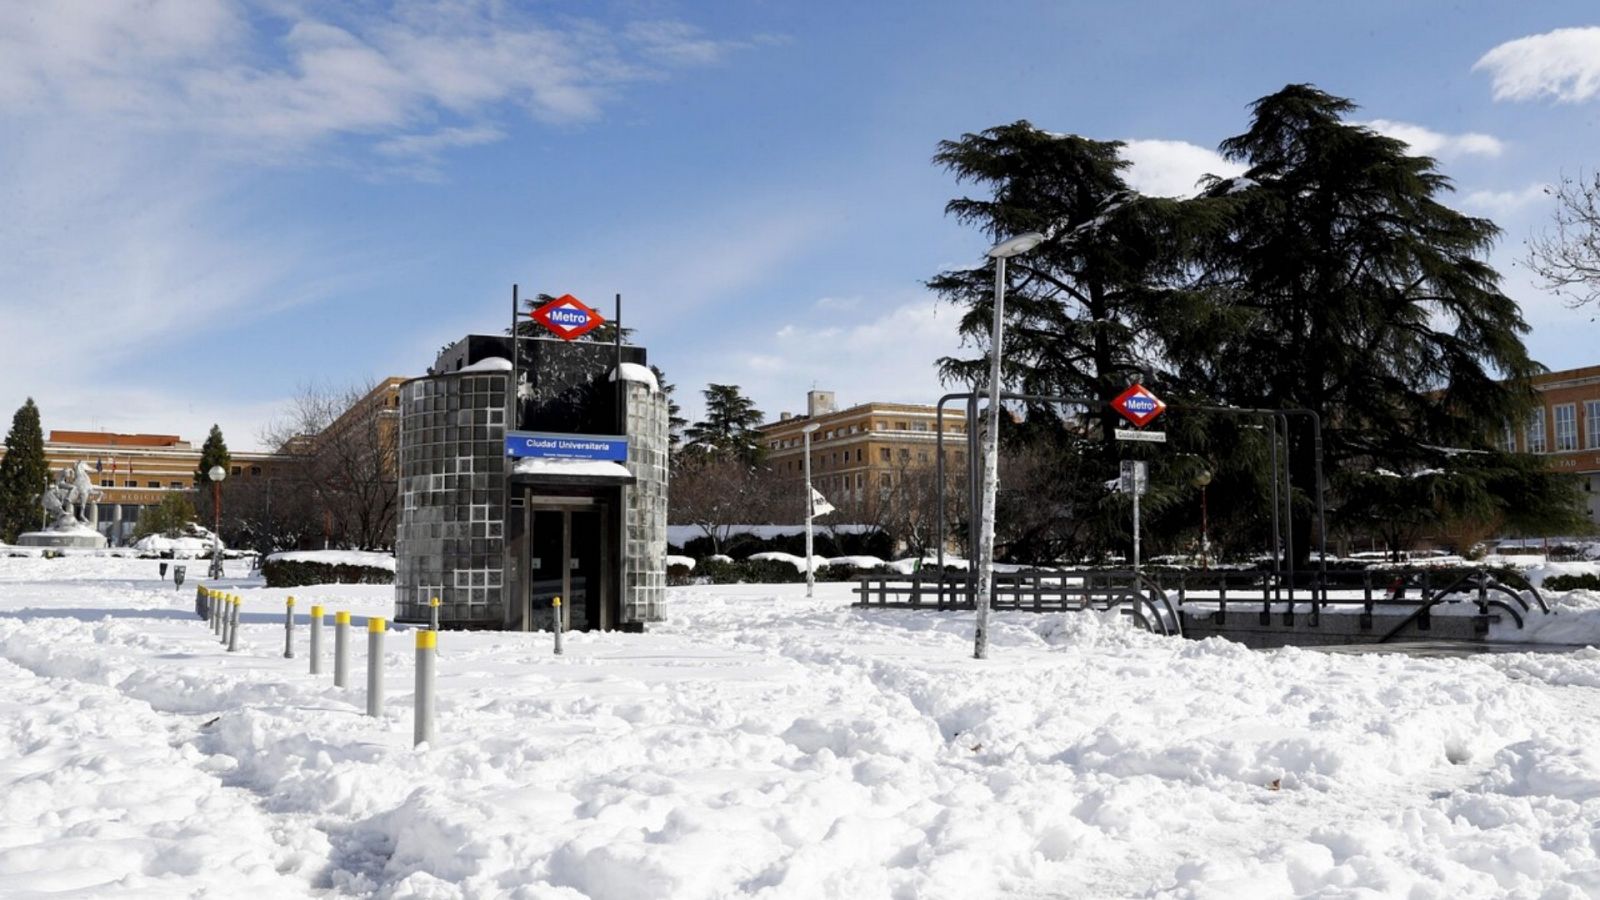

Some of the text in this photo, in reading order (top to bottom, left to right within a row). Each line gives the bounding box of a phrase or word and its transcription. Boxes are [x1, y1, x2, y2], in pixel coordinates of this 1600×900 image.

[552, 310, 585, 323] Metro
[1128, 400, 1153, 410] Metro
[526, 439, 610, 451] Ciudad Universitaria
